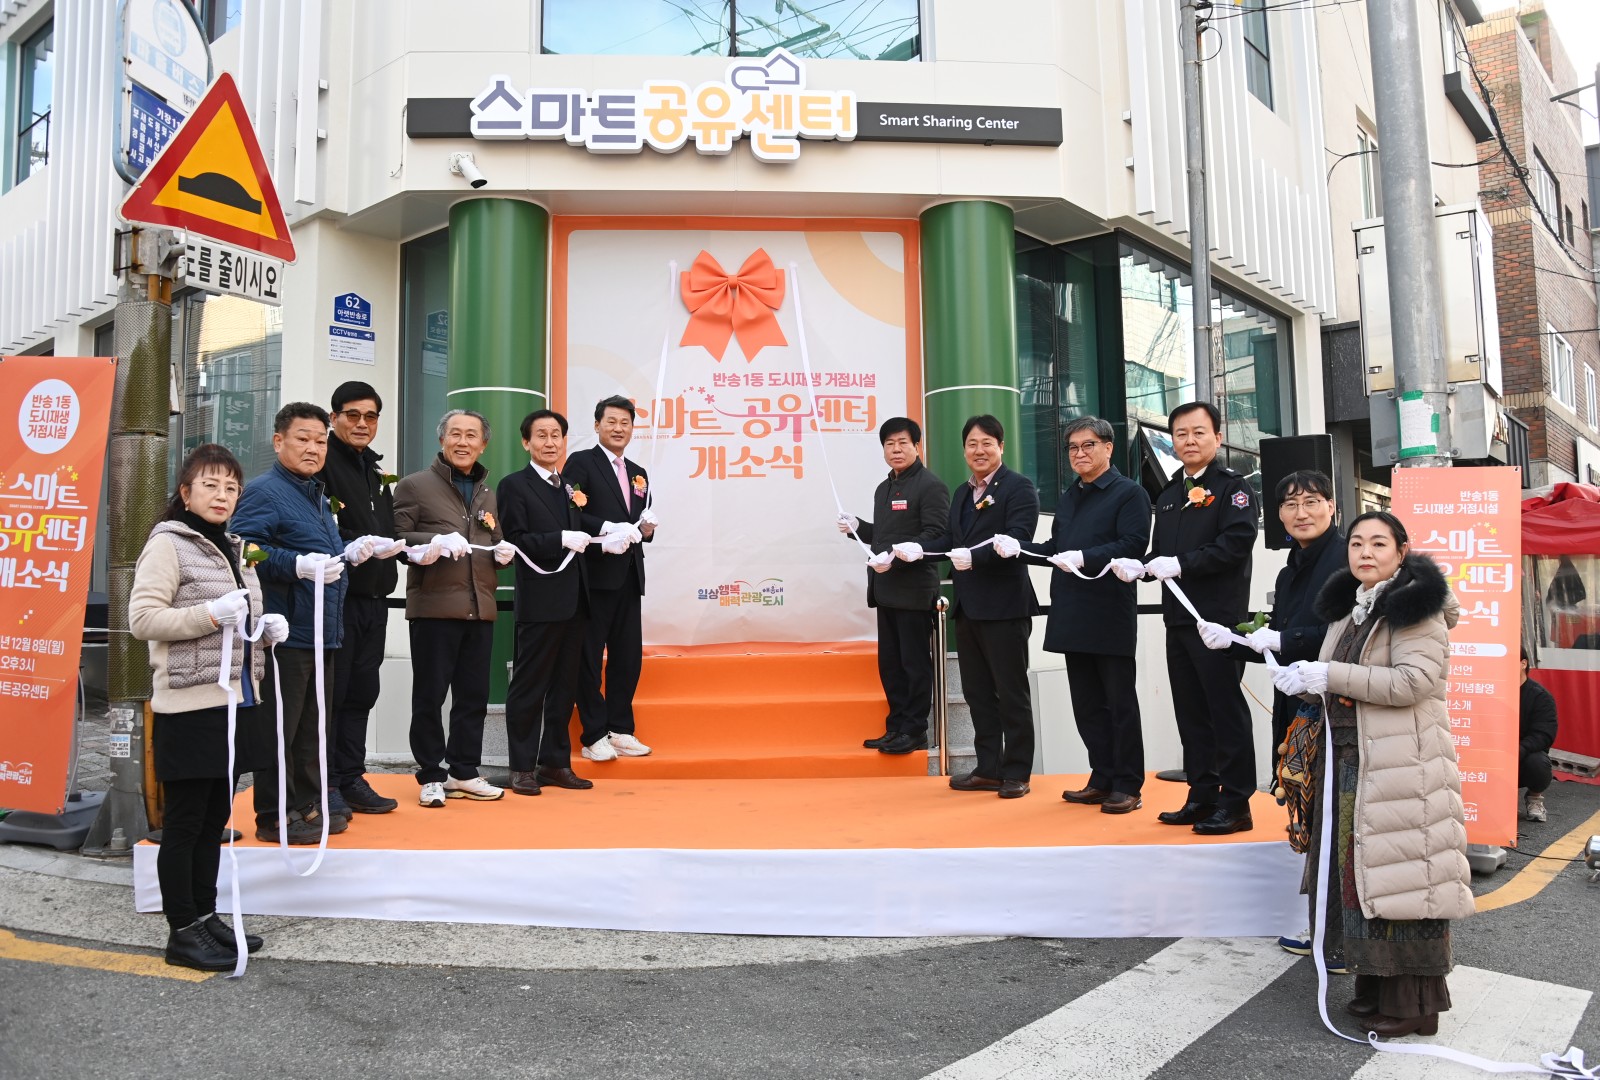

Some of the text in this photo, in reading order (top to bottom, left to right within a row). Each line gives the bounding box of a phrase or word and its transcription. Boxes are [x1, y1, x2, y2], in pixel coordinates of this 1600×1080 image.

[879, 112, 1020, 131] Smart Sharing Center
[218, 250, 278, 298] 줄이시오
[345, 296, 360, 309] 62
[337, 309, 368, 321] 아랫반송로
[712, 372, 876, 388] 반송1동 도시재생 거점시설
[28, 409, 70, 425] 도시재생
[742, 393, 877, 443] 공유센터
[26, 424, 68, 440] 거점시설
[688, 445, 804, 480] 개소식
[0, 472, 88, 510] 스마트
[1412, 503, 1499, 515] 도시재생 거점시설
[1410, 528, 1513, 560] 스마트
[12, 637, 31, 652] 12월
[32, 639, 65, 655] 8일(월)
[1459, 645, 1477, 655] 식순
[1455, 682, 1495, 695] 기념촬영
[1449, 717, 1471, 728] 보고
